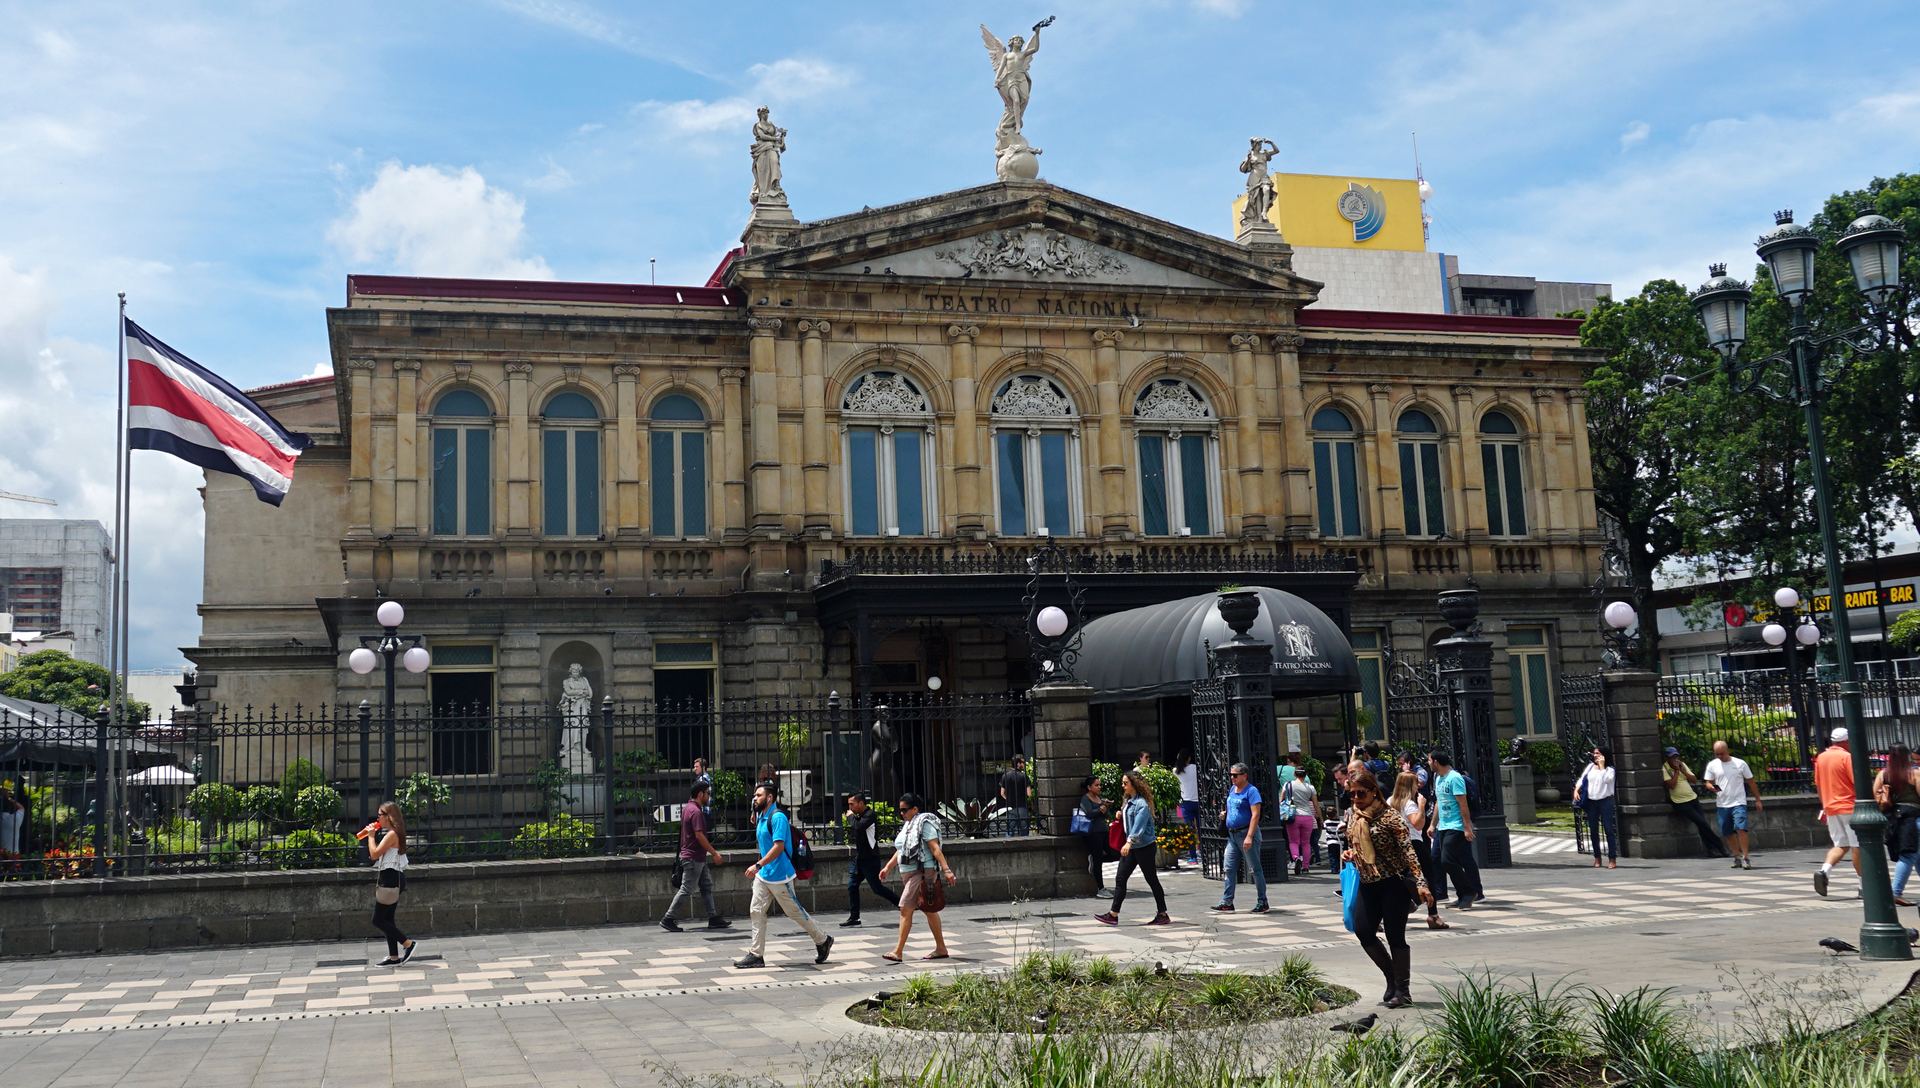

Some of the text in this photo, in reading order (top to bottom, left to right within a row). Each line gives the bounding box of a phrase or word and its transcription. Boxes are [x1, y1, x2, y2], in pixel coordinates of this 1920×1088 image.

[925, 296, 1145, 316] TEATRO NACIONAL
[1890, 586, 1913, 602] BAR
